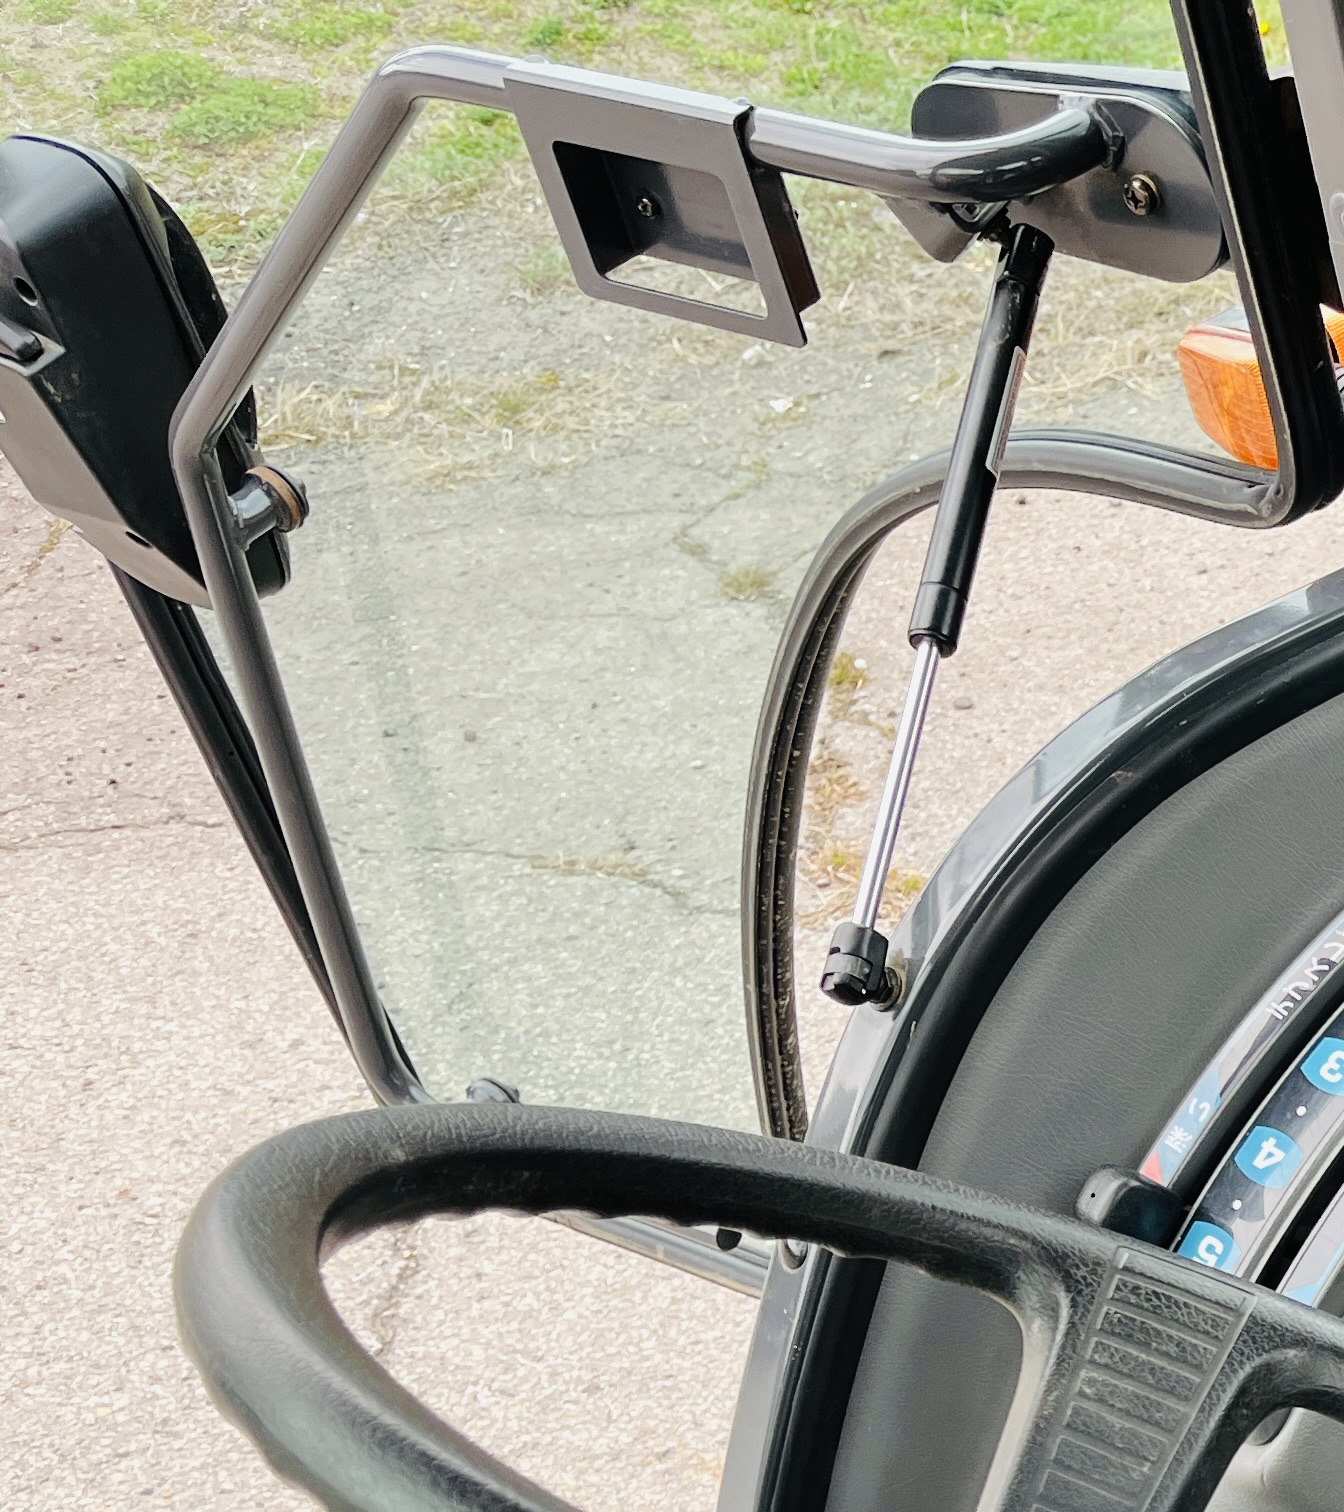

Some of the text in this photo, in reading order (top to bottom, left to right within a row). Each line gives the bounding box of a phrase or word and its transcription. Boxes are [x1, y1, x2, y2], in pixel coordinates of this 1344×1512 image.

[1164, 1095, 1213, 1155] 深い
[1249, 1140, 1287, 1169] 4
[1197, 1235, 1226, 1267] 5
